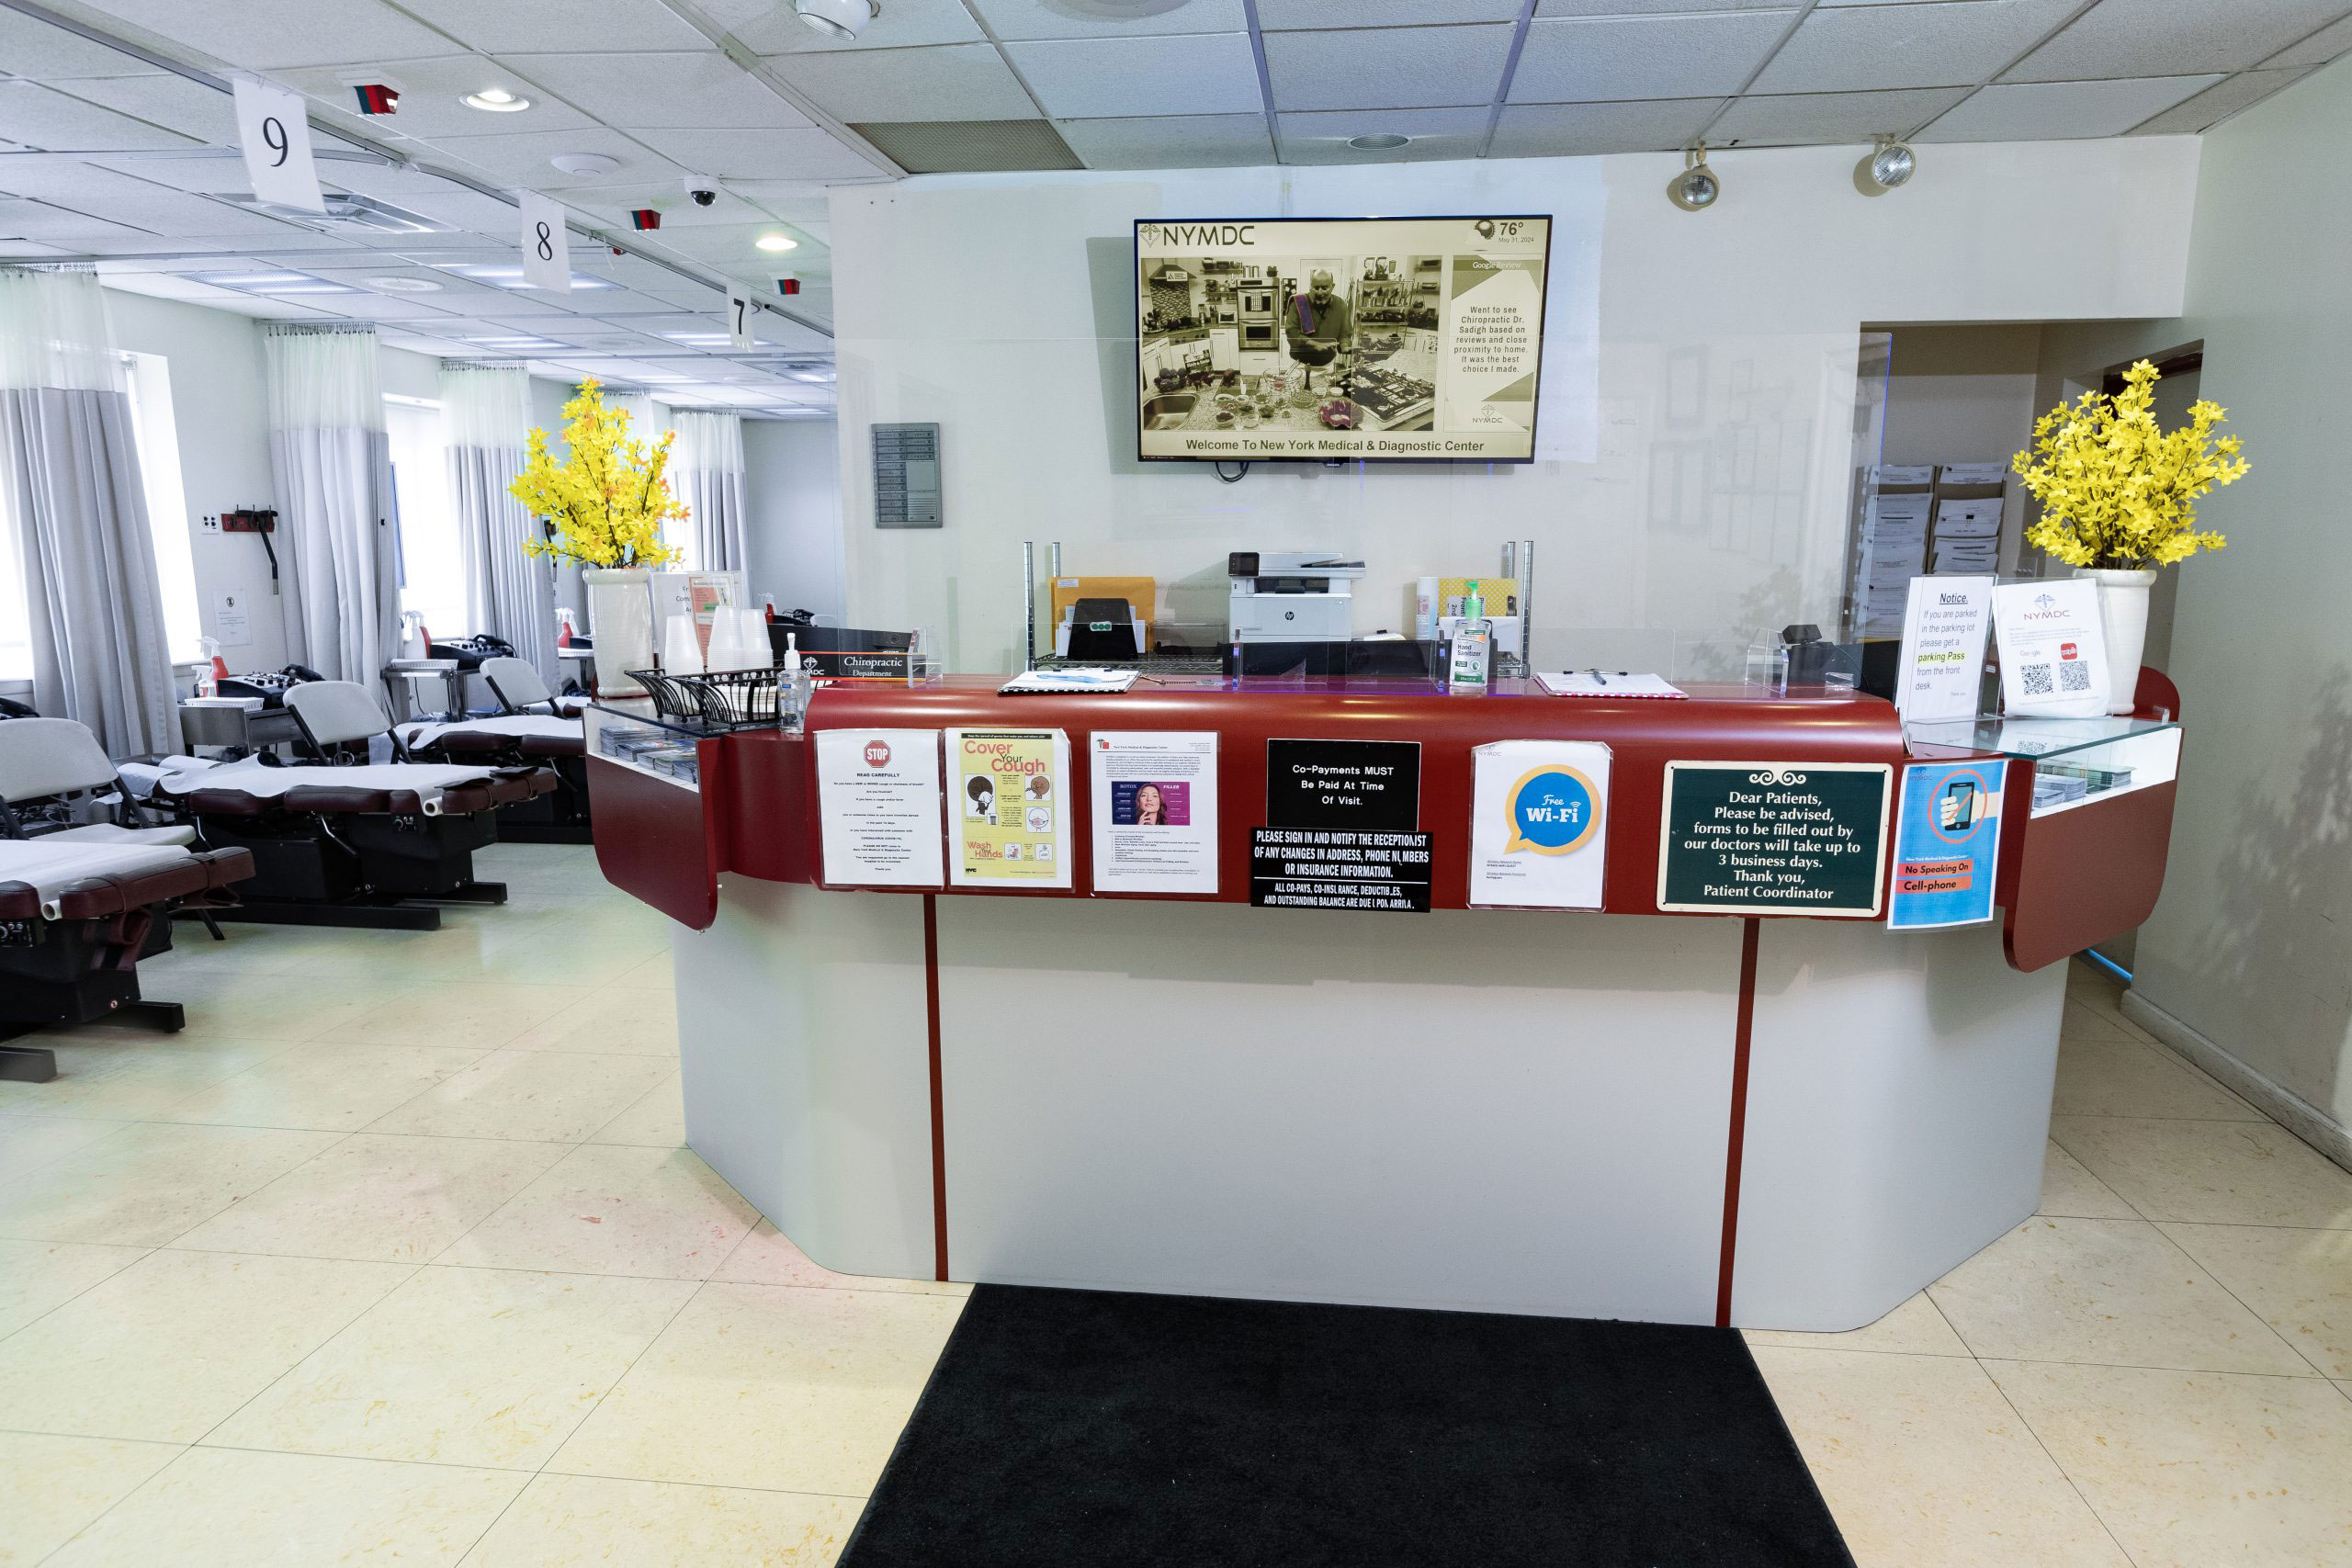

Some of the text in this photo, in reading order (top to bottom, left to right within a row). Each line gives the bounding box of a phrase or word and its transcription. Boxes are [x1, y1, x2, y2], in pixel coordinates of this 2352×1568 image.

[263, 118, 288, 167] 9
[1500, 222, 1523, 235] 76°
[537, 222, 551, 260] 8
[1164, 226, 1254, 245] NYMDC
[734, 298, 744, 334] 7
[1462, 316, 1510, 324] Chiropractic
[1186, 439, 1484, 453] Welcome To New York Medical & Diagnostic Center
[1940, 593, 1968, 603] Notice.
[1929, 612, 1940, 621] you
[1955, 610, 1977, 619] parked
[2024, 610, 2071, 620] NYMDC
[1941, 624, 1964, 634] parking
[1967, 623, 1975, 631] lot
[1920, 639, 1941, 649] please
[1943, 639, 1954, 648] get
[844, 657, 903, 668] Chiropractic
[1918, 652, 1945, 663] parking
[853, 670, 891, 678] Department
[1917, 668, 1931, 676] from
[1933, 667, 1943, 675] the
[1916, 682, 1932, 690] desk.
[965, 740, 1012, 754] Cover
[867, 749, 888, 760] STOP
[1001, 754, 1023, 762] Your
[991, 759, 1045, 775] Cough
[1293, 765, 1394, 775] Co-Payments MUST
[1318, 781, 1340, 789] Paid
[1344, 782, 1355, 790] At
[1360, 782, 1385, 791] Time
[1339, 796, 1363, 805] Visit.
[1542, 795, 1564, 806] Free
[1729, 792, 1822, 807] Dear Patients,
[1526, 807, 1577, 822] Wi-Fi
[1714, 807, 1835, 822] Please be advised,
[1694, 822, 1853, 840] forms to be filled out by
[1257, 830, 1426, 847] PLEASE SIGN IN AND NOTIFY THE RECEPTIONIST
[1684, 839, 1860, 855] our doctors will take up to
[1254, 847, 1264, 858] OF
[1265, 847, 1280, 859] ANY
[1281, 848, 1315, 860] CHANGES
[1317, 849, 1325, 860] IN
[1327, 849, 1363, 863] ADDRESS,
[1365, 851, 1390, 862] PHONE
[1719, 854, 1823, 871] 3 business days.
[1905, 863, 1969, 874] No Speaking On
[1285, 863, 1393, 878] OR INSURANCE INFORMATION.
[1734, 870, 1805, 886] Thank you,
[1275, 883, 1285, 892] ALL
[1286, 884, 1312, 894] CO-PAYS,
[1361, 886, 1402, 897] DEDUCTIBES,
[1704, 886, 1834, 899] Patient Coordinator
[1904, 880, 1956, 893] Cell-phone
[1264, 895, 1276, 904] AND
[1278, 896, 1317, 906] OUTSTANDING
[1318, 897, 1345, 907] BALANCE
[1346, 897, 1358, 907] ARE
[1359, 898, 1371, 908] DUE
